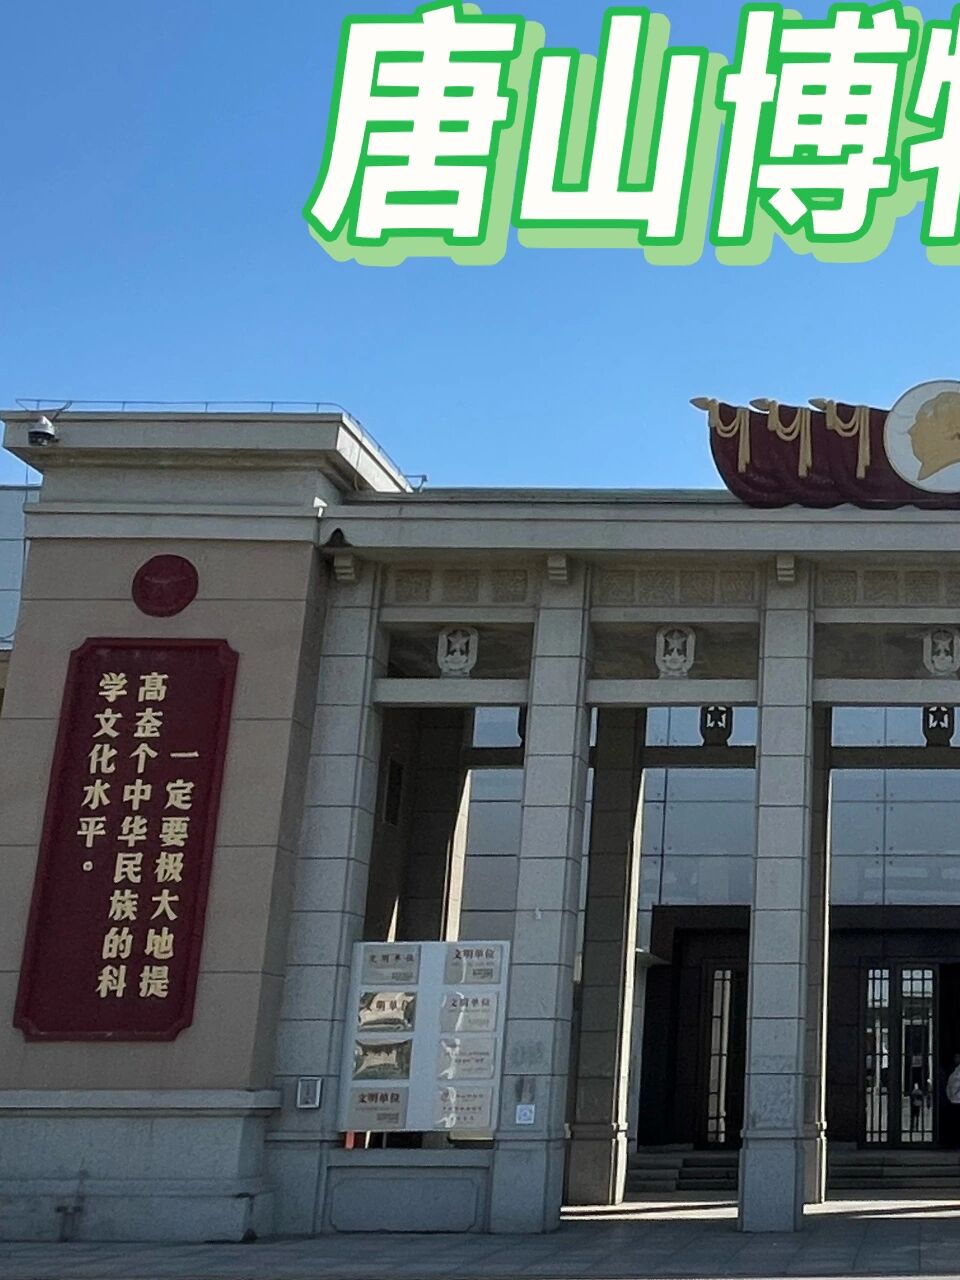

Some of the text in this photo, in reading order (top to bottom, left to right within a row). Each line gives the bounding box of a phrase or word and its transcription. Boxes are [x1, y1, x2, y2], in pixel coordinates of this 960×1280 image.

[76, 671, 129, 873] 学文化水平。
[139, 749, 200, 999] 一定要极大地提
[455, 948, 495, 960] 文明单位
[358, 1092, 400, 1104] 文明单位
